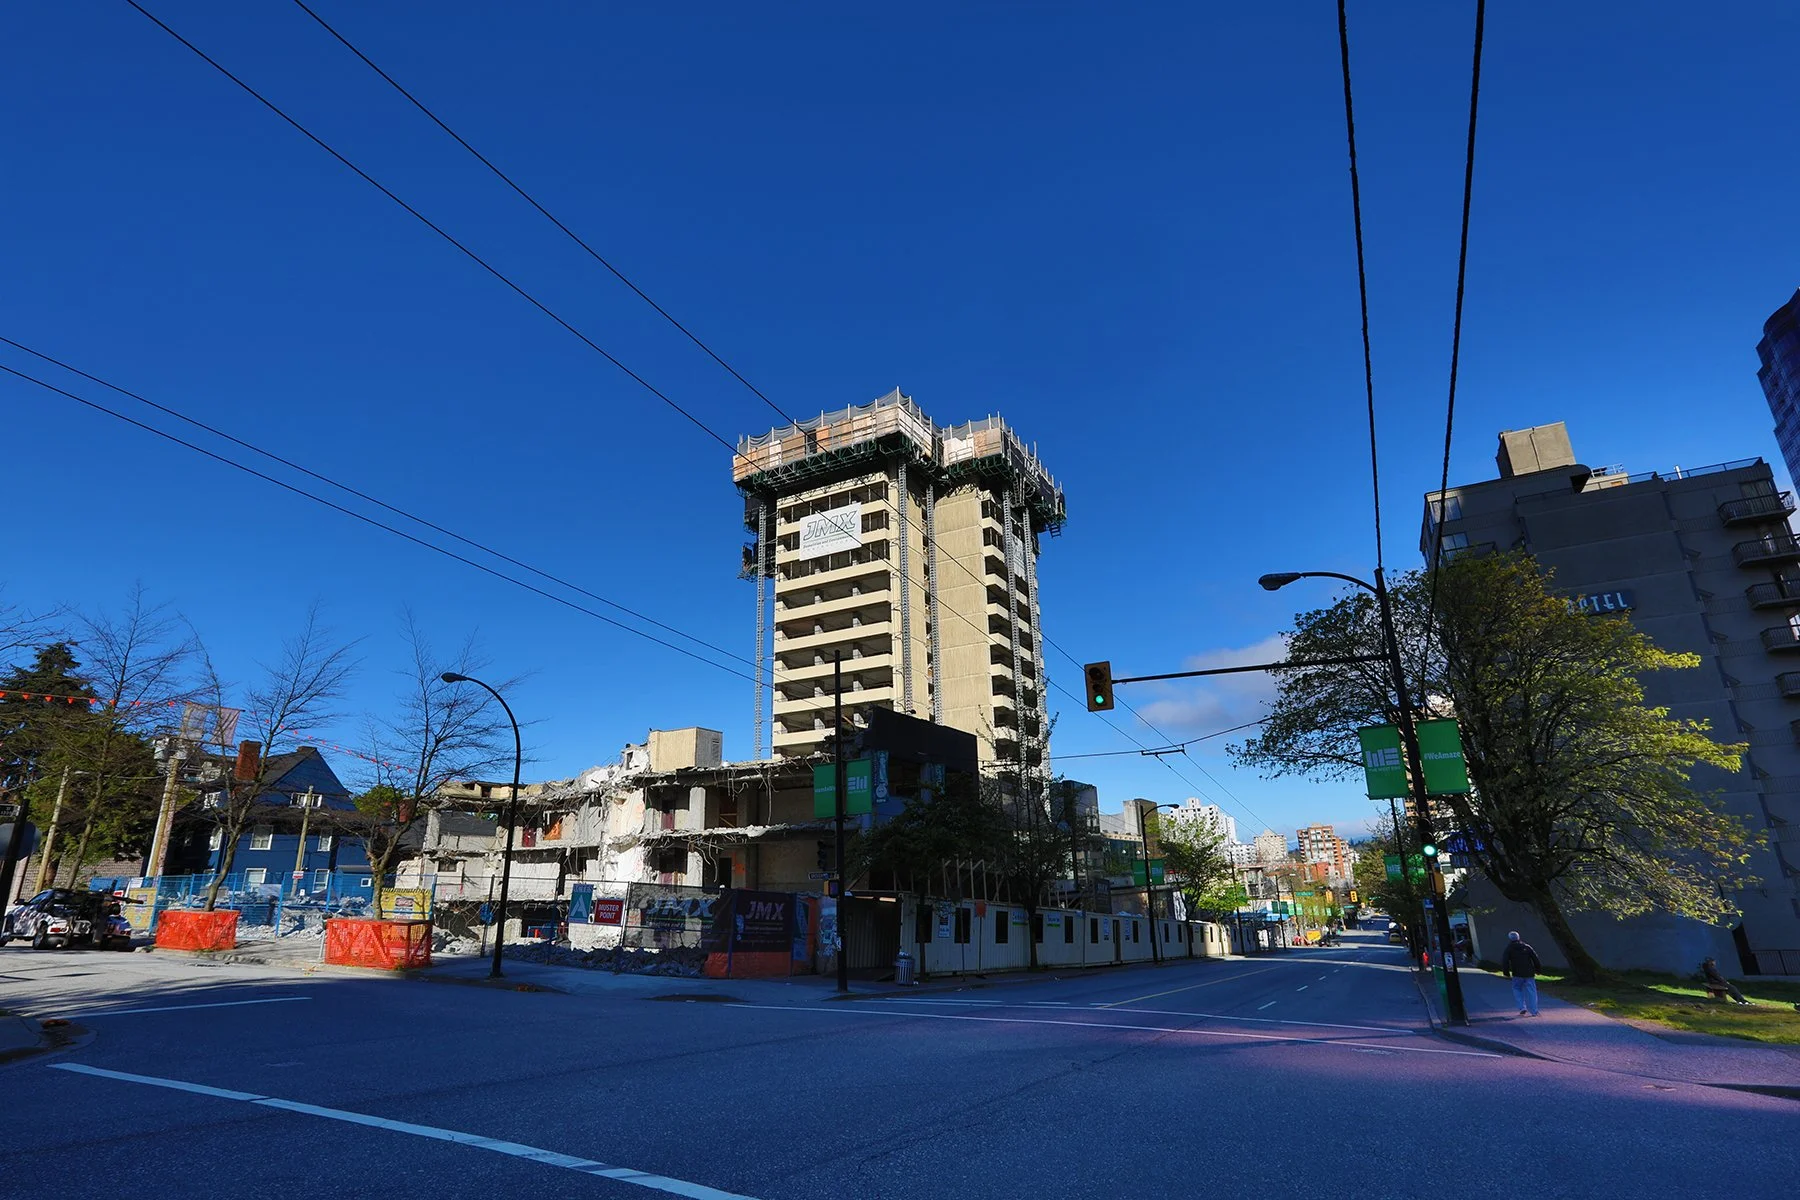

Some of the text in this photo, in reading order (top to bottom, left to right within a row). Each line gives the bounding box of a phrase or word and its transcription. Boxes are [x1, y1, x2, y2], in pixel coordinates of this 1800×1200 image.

[803, 511, 857, 541] JMX
[598, 904, 620, 912] MUSTER
[600, 911, 616, 920] POINT
[744, 900, 785, 921] JMX
